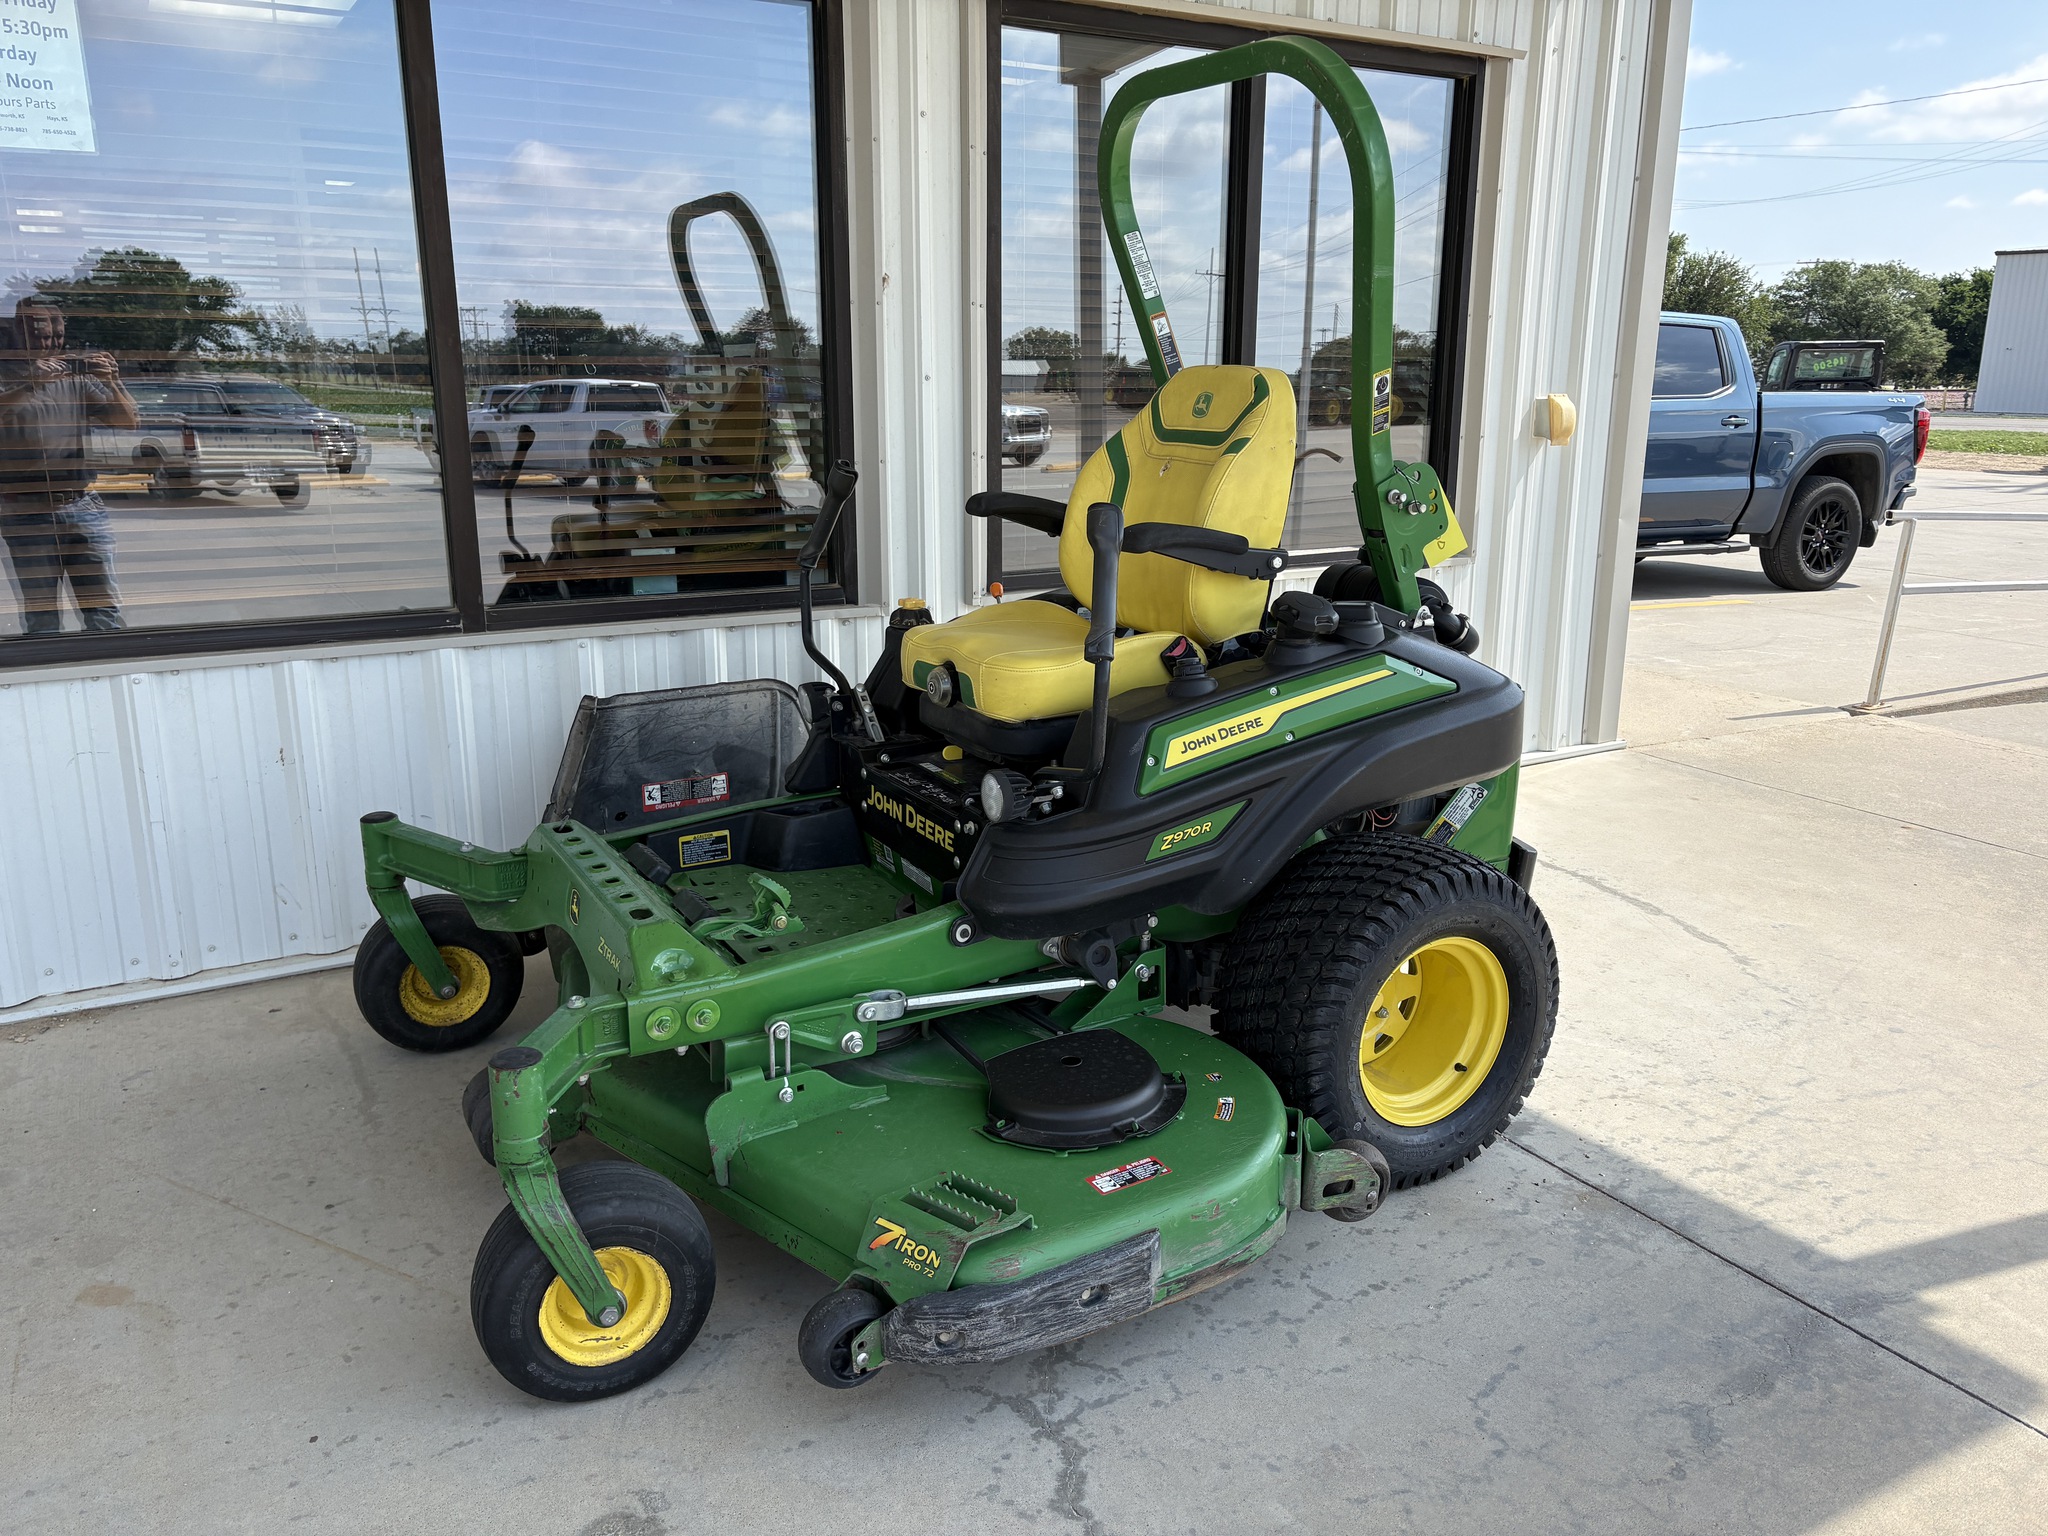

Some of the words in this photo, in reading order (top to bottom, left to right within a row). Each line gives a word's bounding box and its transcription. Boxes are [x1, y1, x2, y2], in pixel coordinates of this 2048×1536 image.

[2, 18, 69, 41] 5:30pm
[6, 72, 54, 91] Noon
[25, 96, 57, 110] Parts
[1180, 733, 1217, 754] JOHN
[1217, 716, 1264, 741] DEERE
[867, 784, 903, 823] JOHN
[905, 803, 955, 853] DEERE
[1160, 821, 1212, 851] Z970R
[597, 936, 621, 973] ZTRAK
[902, 1257, 922, 1271] PRO
[922, 1267, 935, 1278] 72
